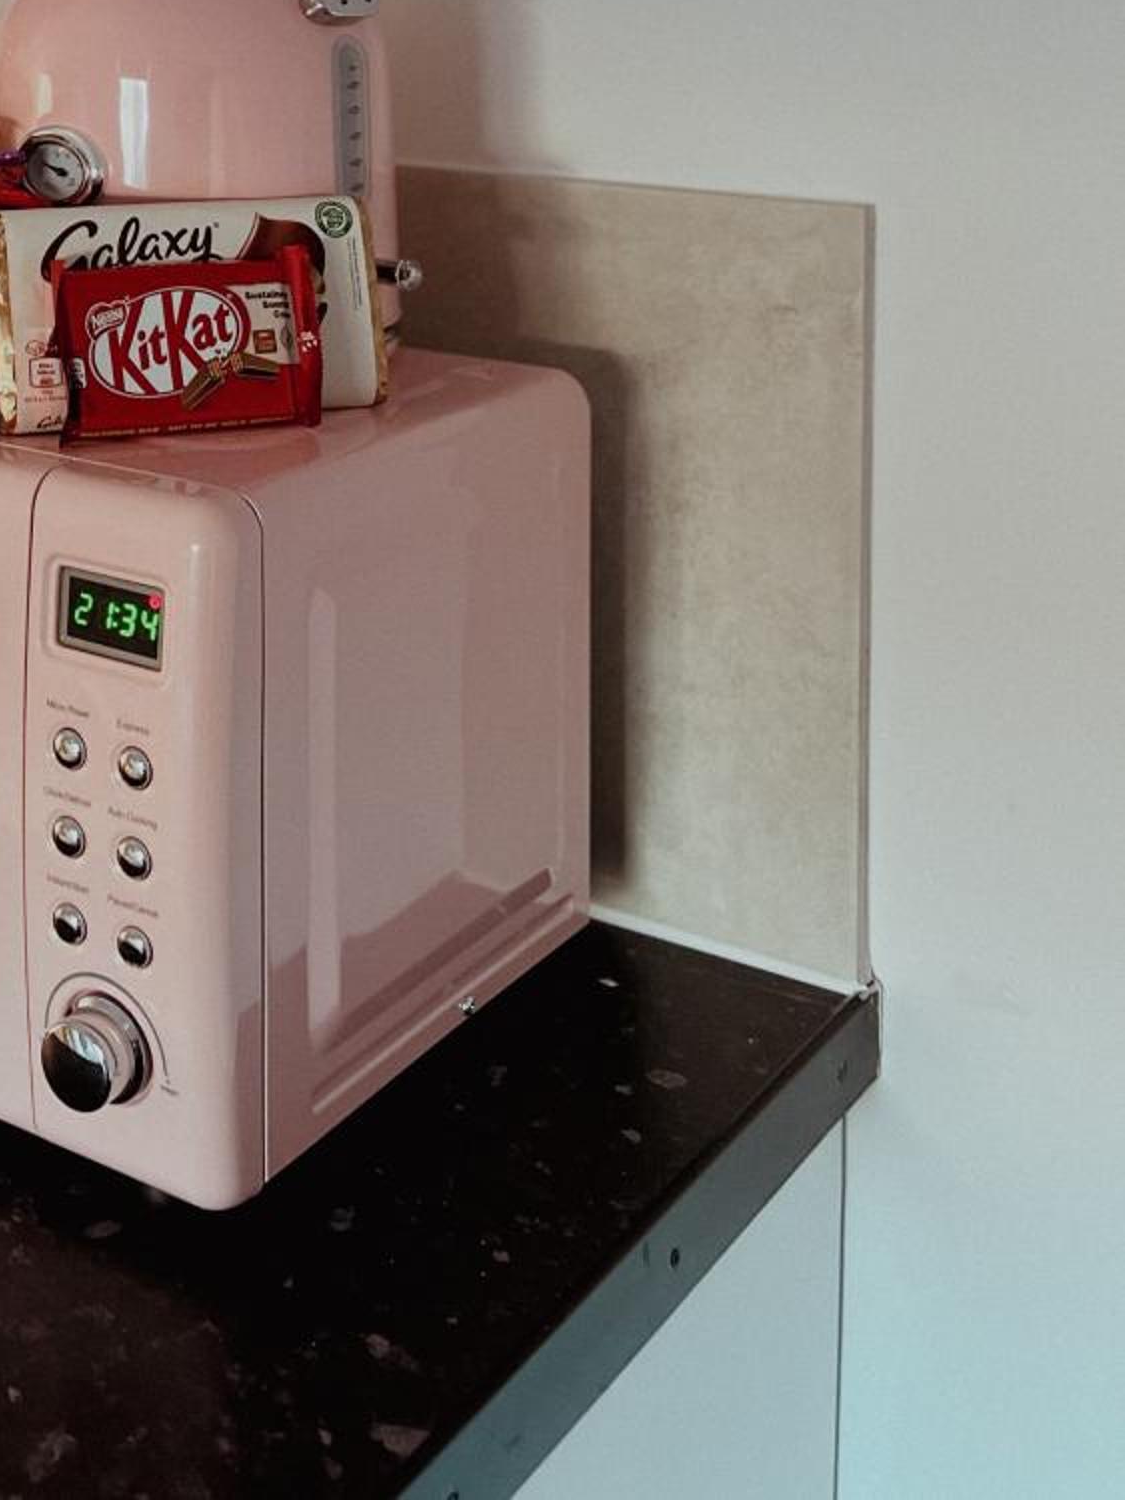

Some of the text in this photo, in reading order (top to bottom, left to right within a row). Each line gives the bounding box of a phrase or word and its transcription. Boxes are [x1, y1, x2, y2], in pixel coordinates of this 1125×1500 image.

[41, 216, 222, 282] Galaxy
[107, 291, 233, 394] KitKat
[74, 587, 159, 641] 21:34
